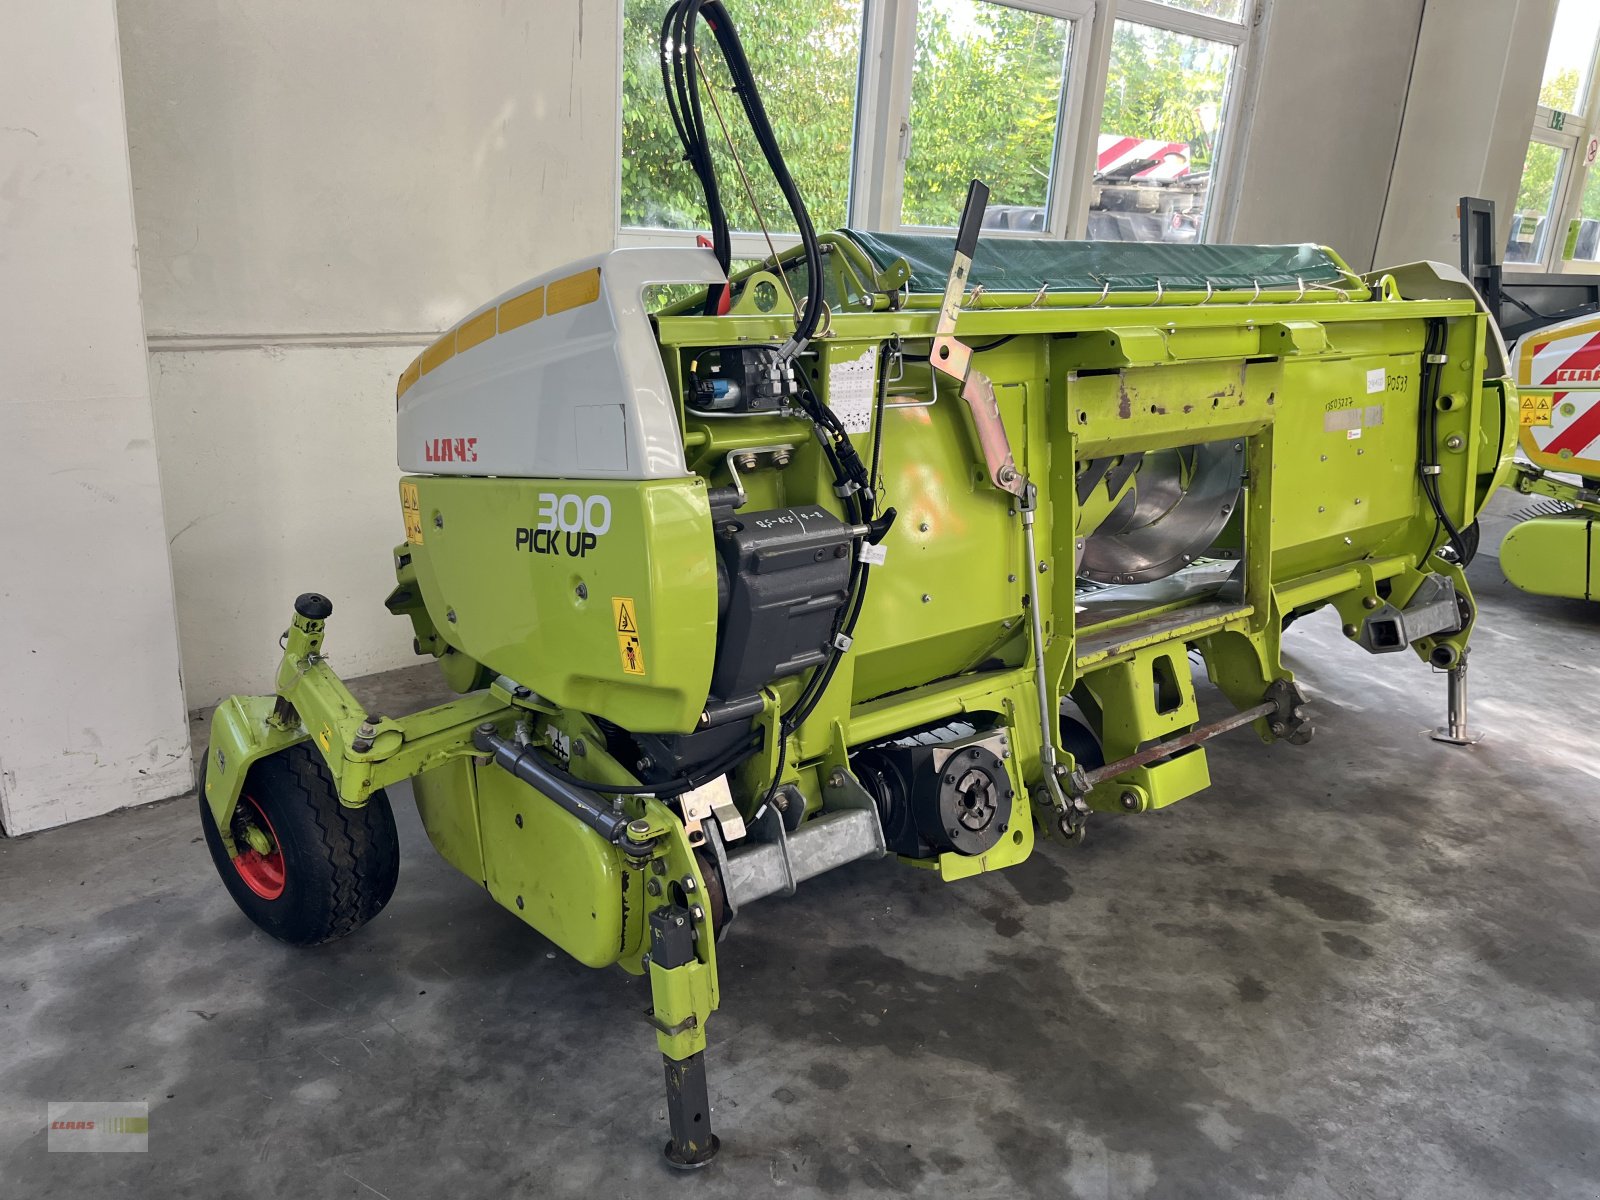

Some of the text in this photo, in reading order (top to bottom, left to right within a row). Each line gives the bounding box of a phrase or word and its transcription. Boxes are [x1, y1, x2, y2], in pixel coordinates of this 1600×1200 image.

[537, 493, 611, 536] 300
[515, 528, 597, 558] PICK UP
